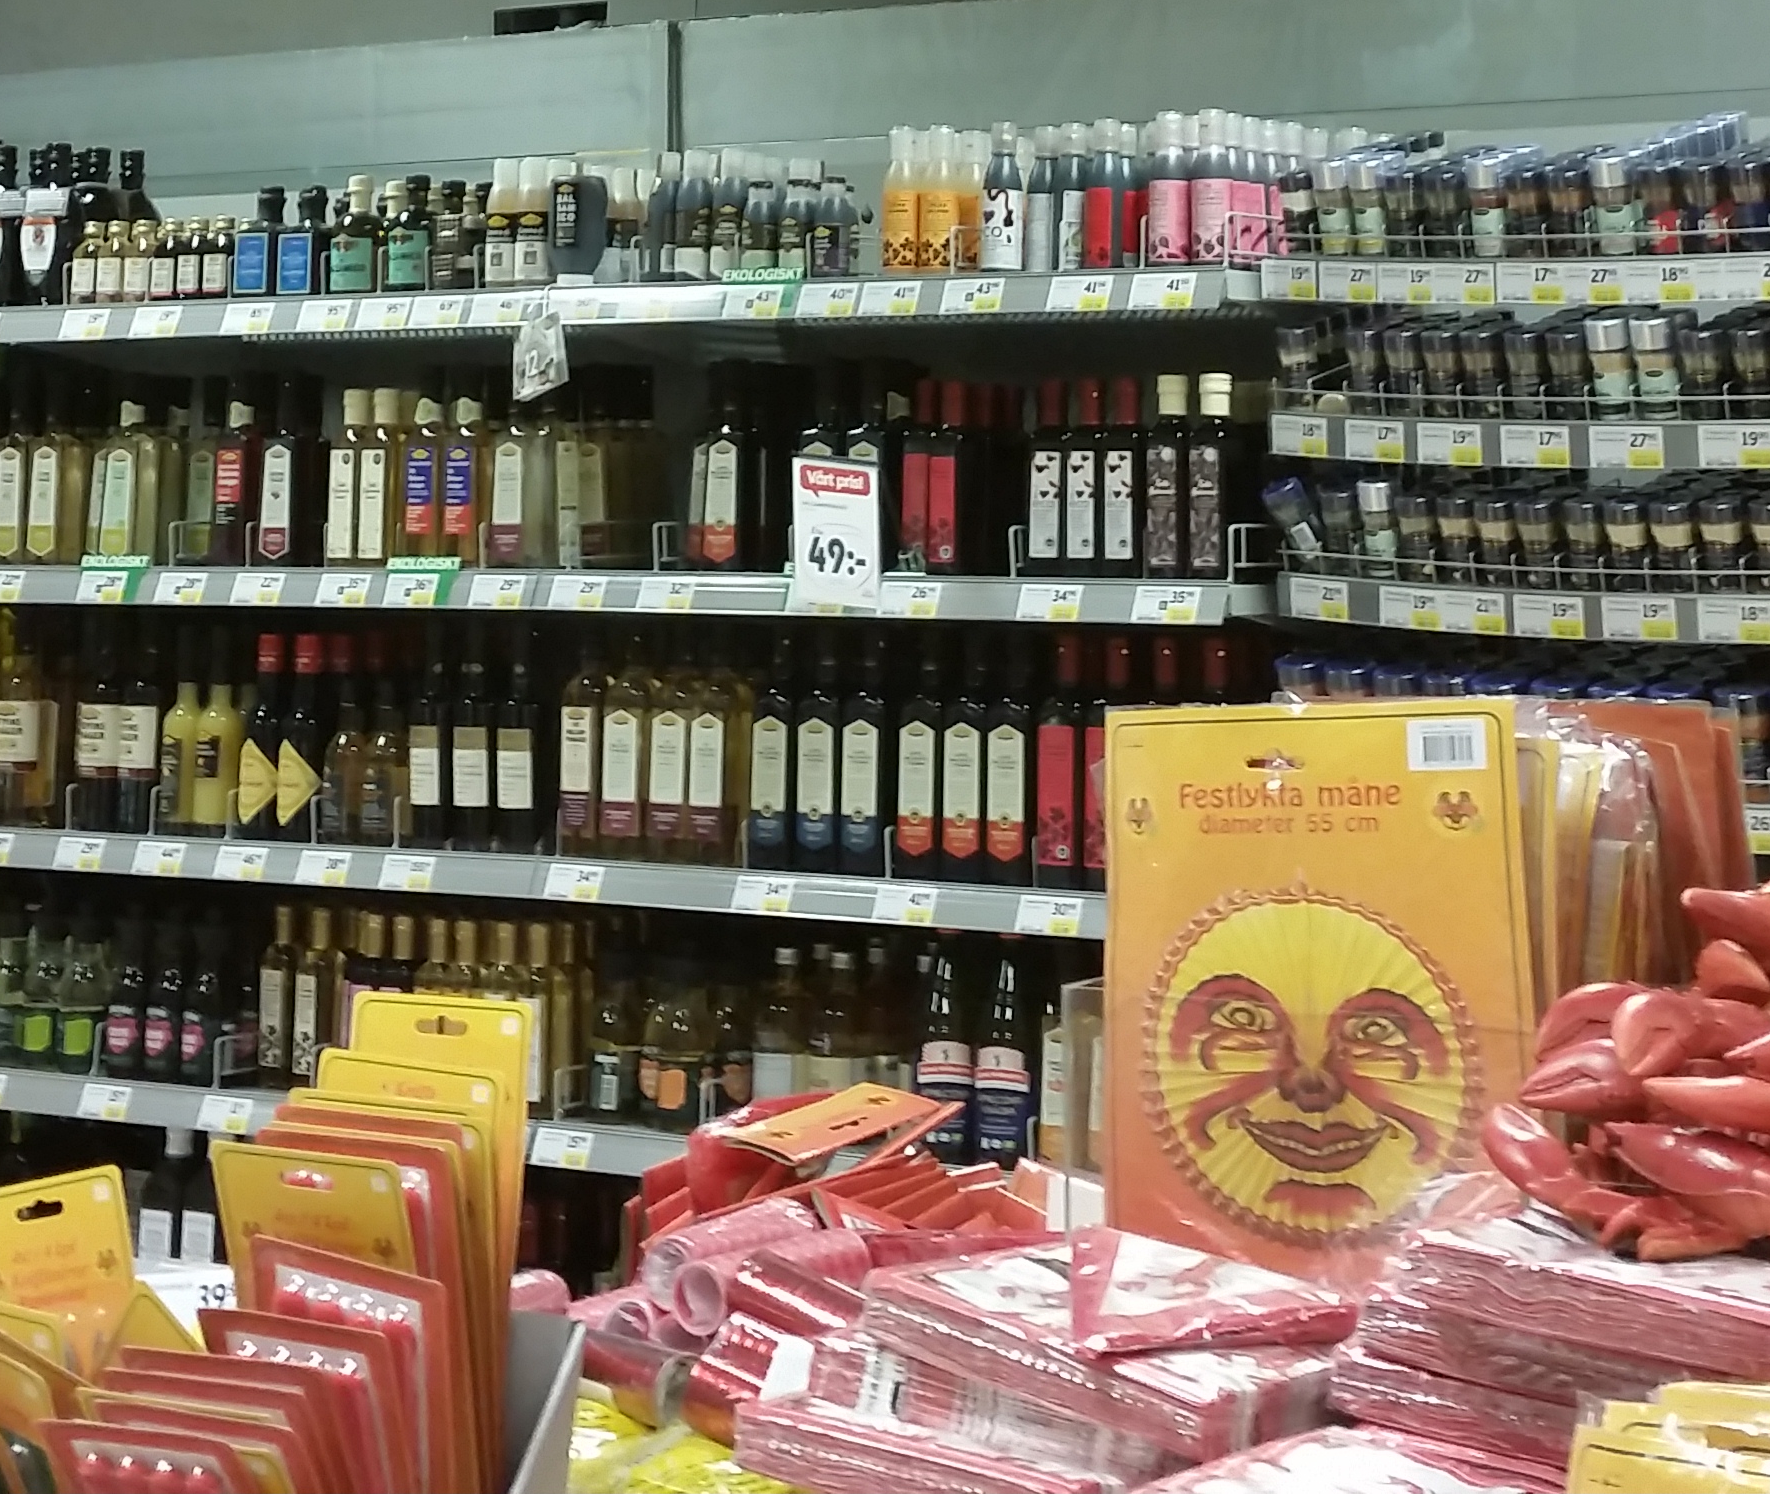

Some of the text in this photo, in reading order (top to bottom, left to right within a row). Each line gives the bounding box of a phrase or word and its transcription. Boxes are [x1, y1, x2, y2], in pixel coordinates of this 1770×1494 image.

[722, 267, 804, 282] EKOLOGISKT
[808, 536, 867, 576] 49:-
[1179, 776, 1401, 808] Festlykta måne
[1199, 813, 1379, 834] diameter 55 cm
